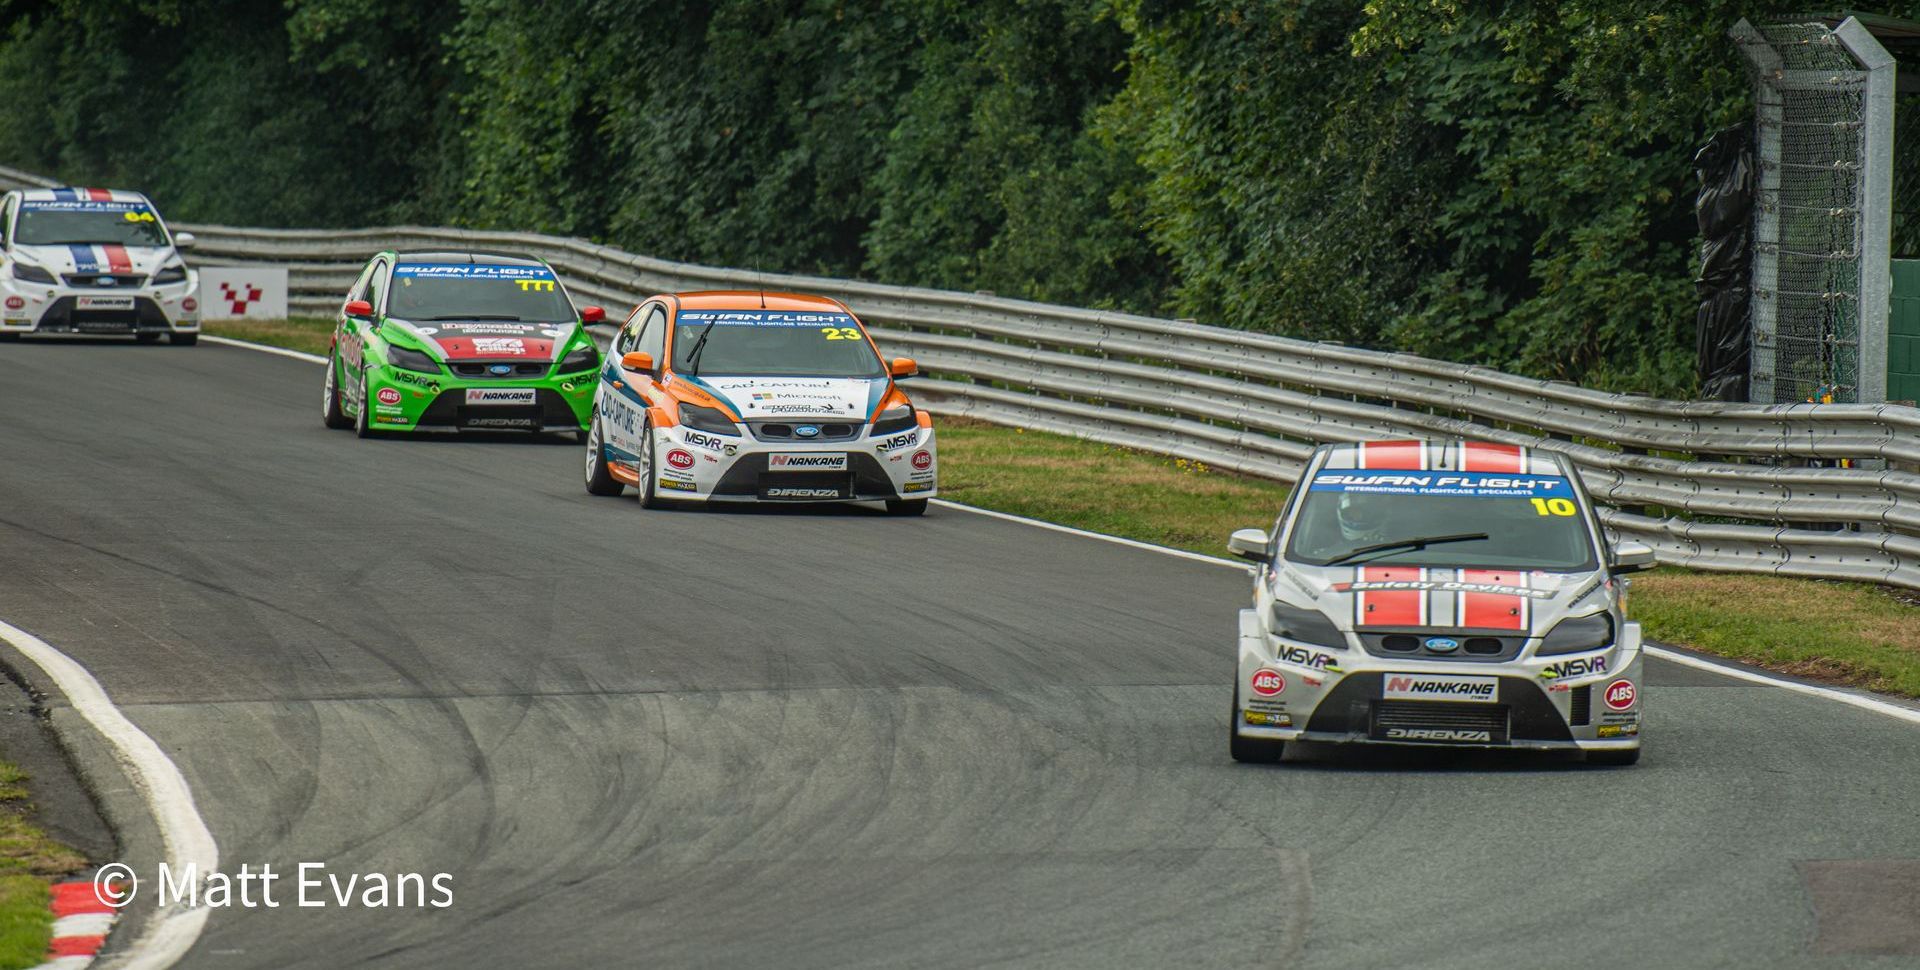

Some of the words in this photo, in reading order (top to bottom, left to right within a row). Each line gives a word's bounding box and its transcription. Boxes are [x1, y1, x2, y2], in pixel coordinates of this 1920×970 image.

[474, 267, 548, 275] FLIGHT
[515, 280, 555, 291] 777
[680, 313, 762, 321] SWAN
[822, 328, 861, 341] 23
[395, 371, 428, 386] MSVR
[380, 392, 398, 400] ABS
[777, 393, 841, 401] Microsoft
[685, 431, 722, 449] MSVR
[887, 433, 916, 449] MSVR
[671, 454, 691, 464] ABS
[787, 457, 845, 466] NANKANG
[915, 455, 930, 464] ABS
[1314, 475, 1432, 486] SWAN
[1437, 477, 1561, 489] FLIGHT
[767, 488, 839, 497] DIRENZA
[1530, 498, 1576, 516] 10
[1351, 581, 1436, 591] Safety
[1441, 582, 1547, 598] Devices
[1278, 645, 1328, 668] MSVR
[1554, 656, 1606, 677] MSVR
[1254, 676, 1281, 689] ABS
[1411, 681, 1495, 695] NANKANG
[1610, 686, 1633, 702] ABS
[1387, 729, 1491, 741] DIRENZA
